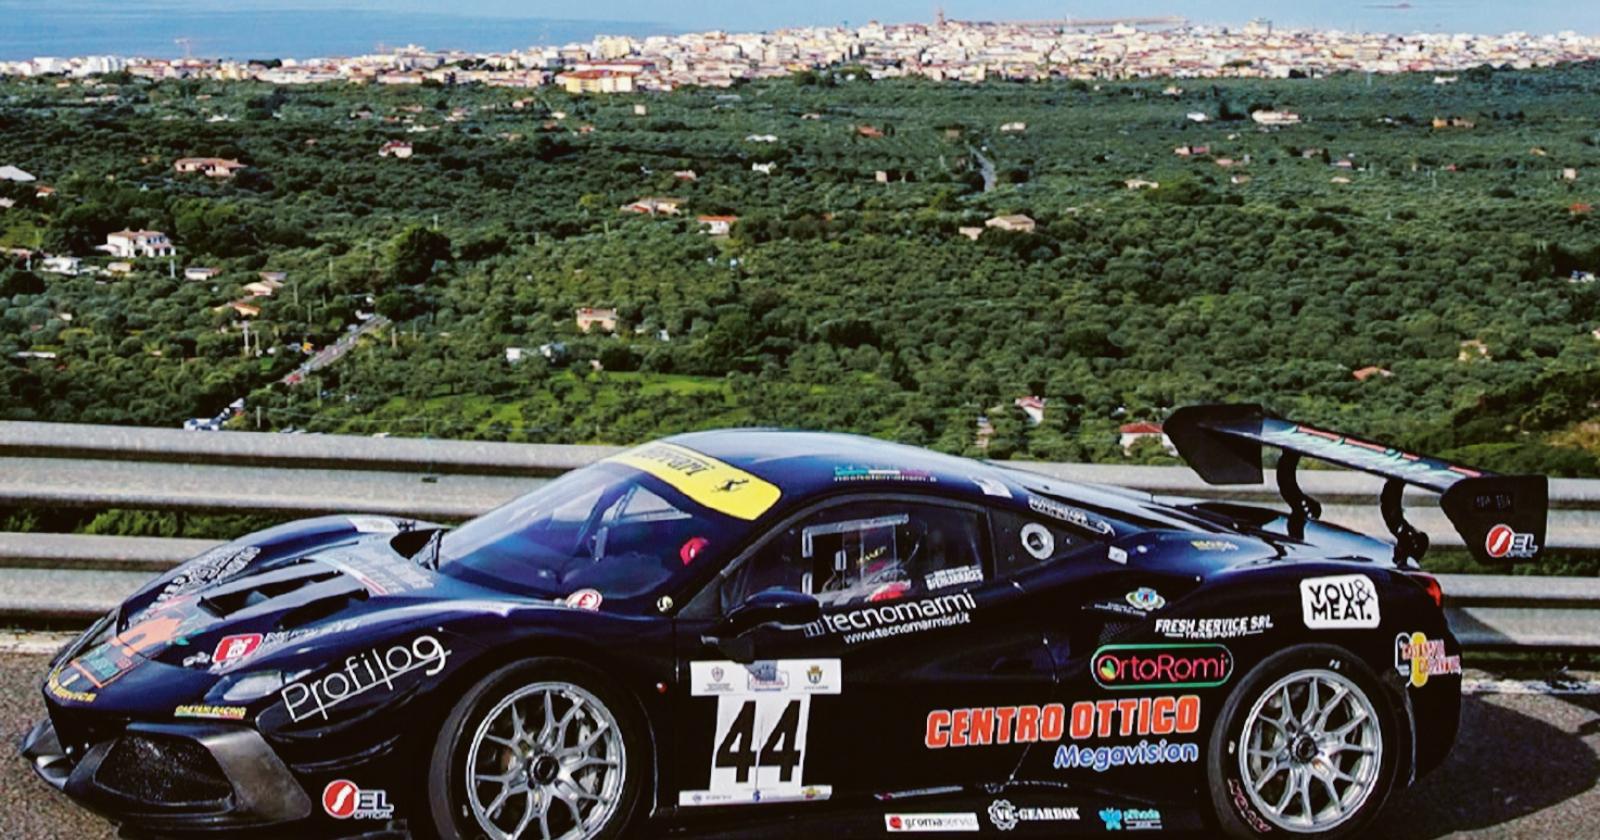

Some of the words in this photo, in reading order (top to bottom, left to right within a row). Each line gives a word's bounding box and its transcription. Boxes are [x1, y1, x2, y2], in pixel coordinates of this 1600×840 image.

[823, 589, 976, 633] tecnomarmi
[1155, 618, 1195, 633] FRESH
[1198, 617, 1248, 633] SERVICE
[1250, 614, 1273, 630] SRL
[1311, 601, 1372, 621] MEAT.
[281, 635, 447, 722] Profilog
[1097, 653, 1227, 682] OrtoRomi
[925, 703, 1065, 748] CENTRO
[1069, 695, 1200, 739] OTTICO
[715, 700, 801, 783] 44
[1053, 739, 1199, 771] Megavision
